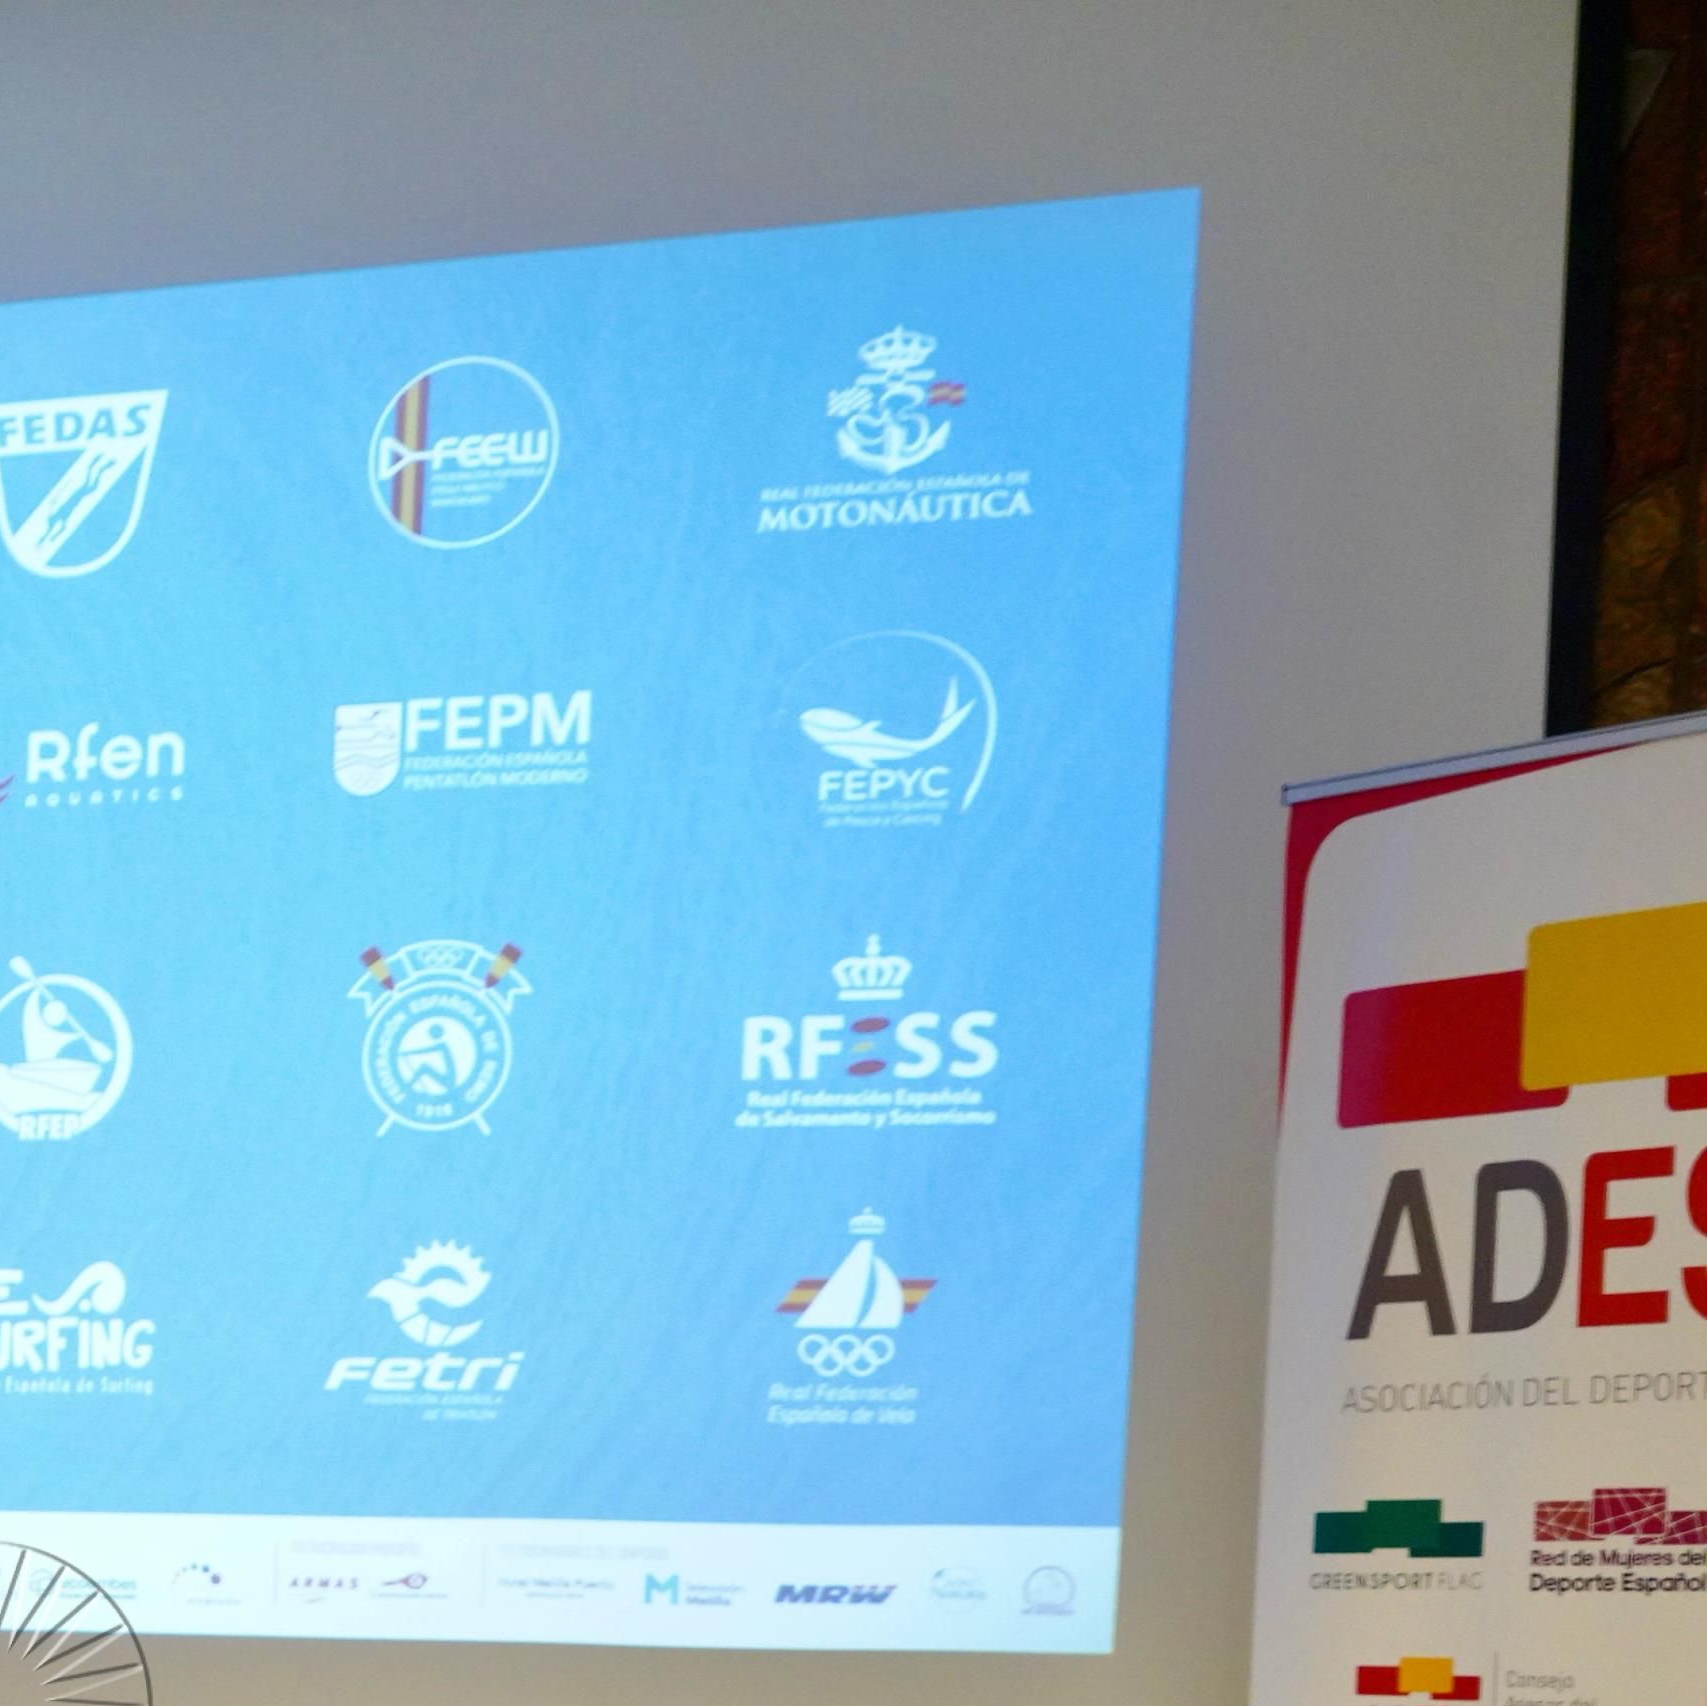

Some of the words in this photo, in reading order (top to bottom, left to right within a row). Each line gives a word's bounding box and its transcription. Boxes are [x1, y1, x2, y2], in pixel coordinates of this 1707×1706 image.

[756, 488, 1033, 534] MOTONÁUTICA
[404, 690, 593, 752] FEPM
[818, 766, 951, 801] FEPYC
[1342, 1372, 1515, 1415] ASOCIACIÓN
[1522, 1375, 1580, 1407] DEL
[1530, 1549, 1566, 1567] Red
[1570, 1549, 1594, 1567] de
[1599, 1549, 1675, 1570] Mujeres
[774, 1583, 899, 1605] MRW
[1530, 1572, 1616, 1596] Deporte
[1505, 1670, 1576, 1693] Consejo
